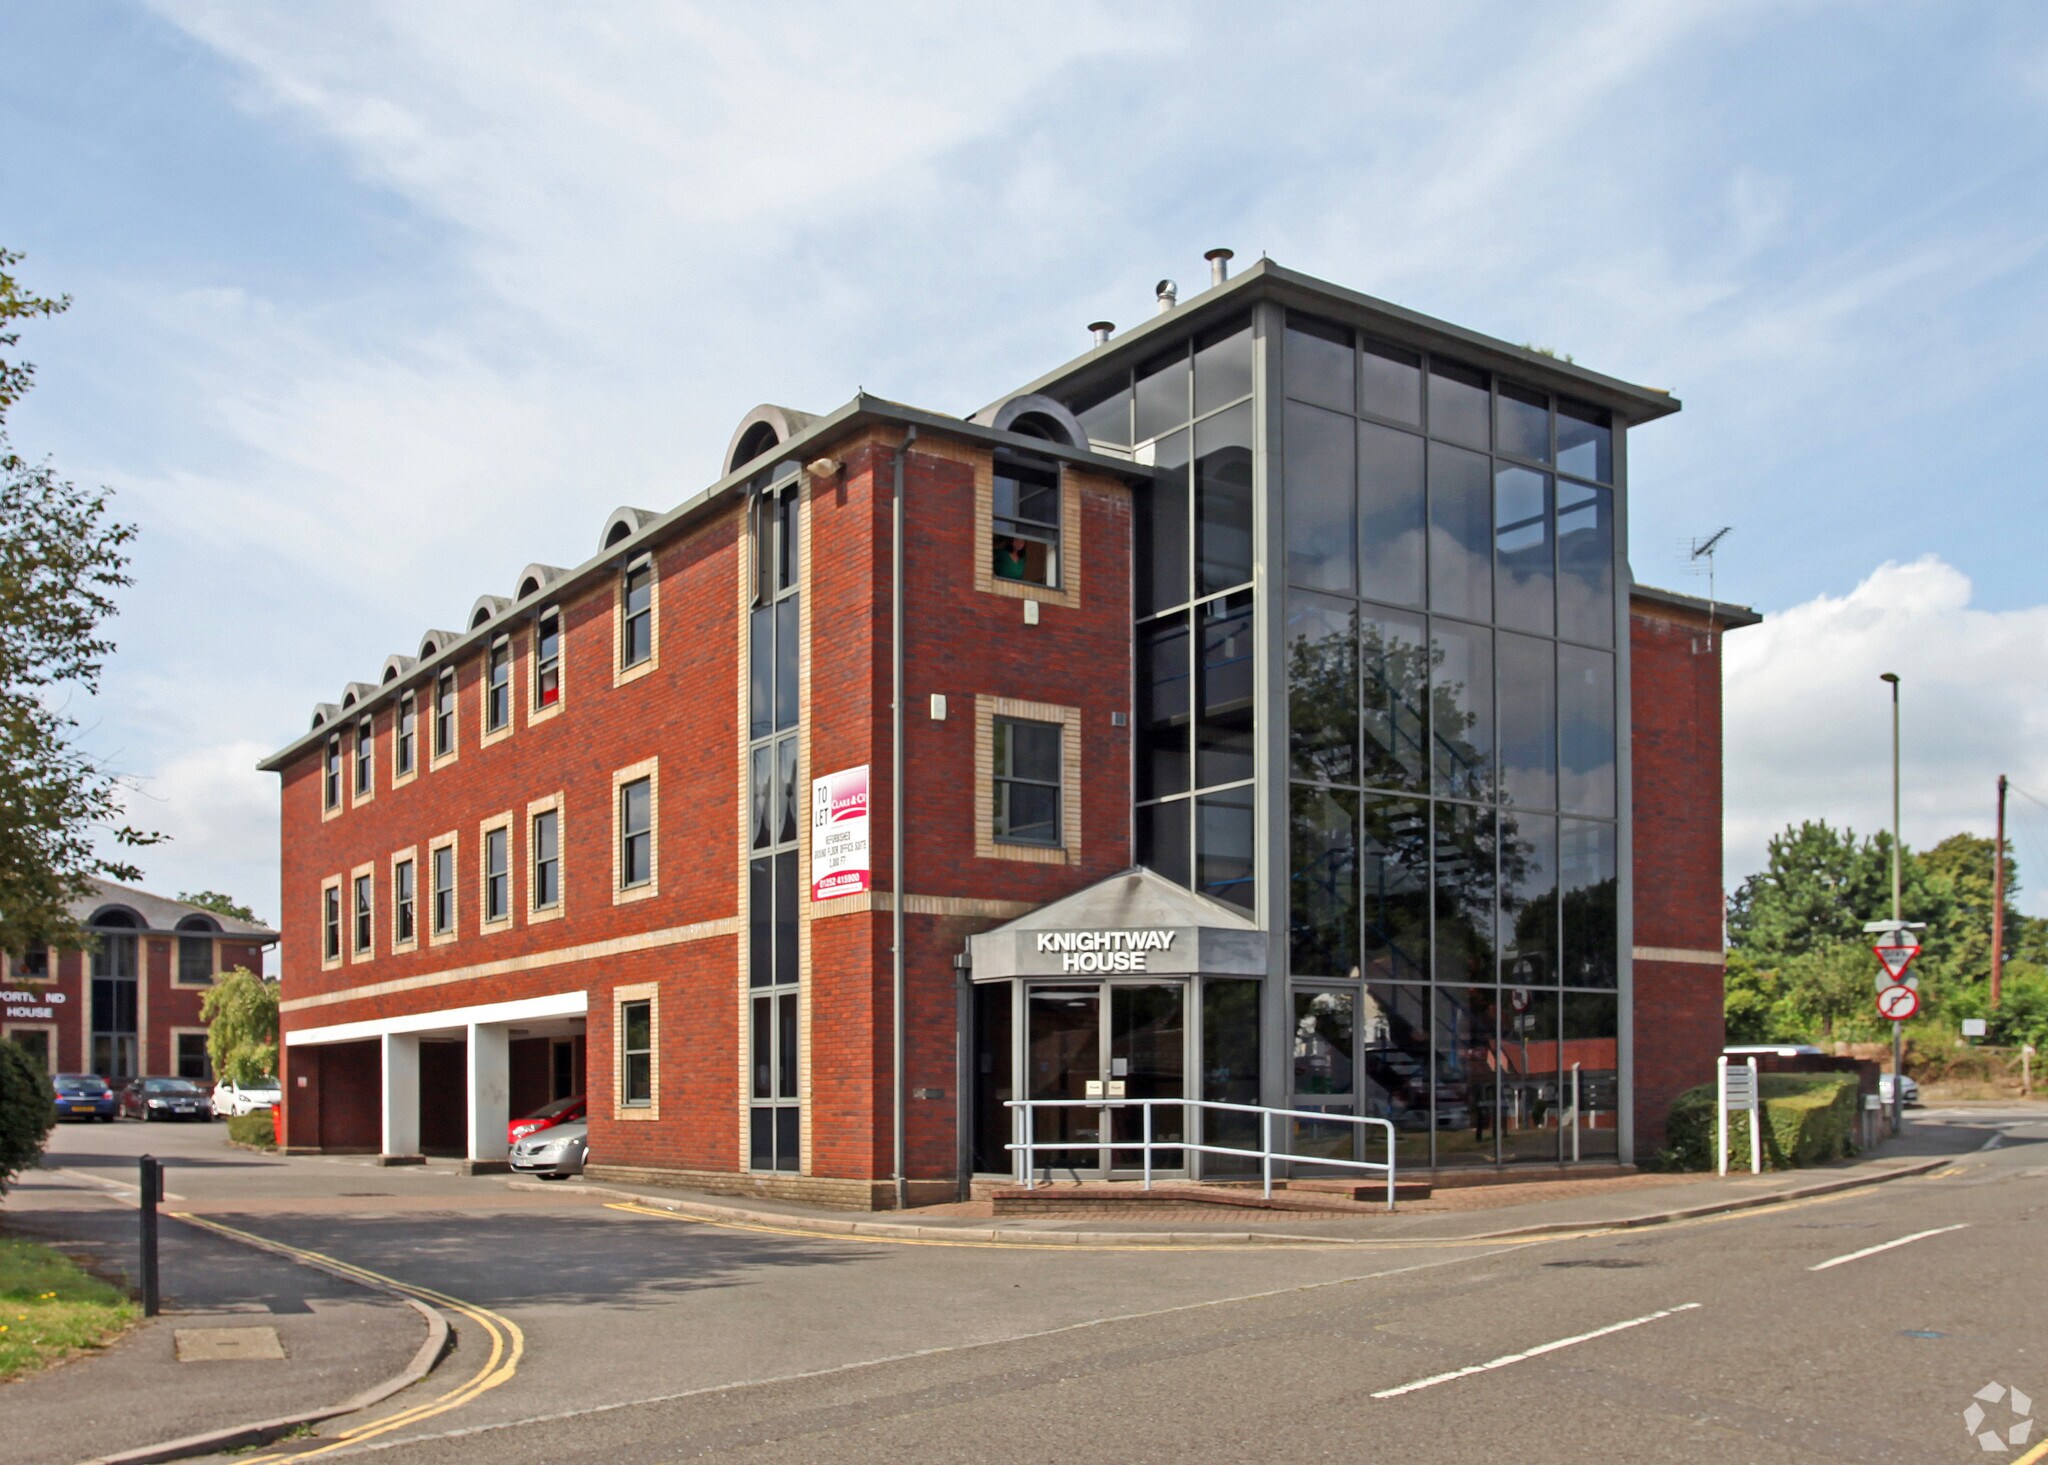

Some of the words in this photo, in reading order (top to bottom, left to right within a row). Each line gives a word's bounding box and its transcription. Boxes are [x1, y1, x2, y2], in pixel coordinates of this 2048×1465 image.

[818, 785, 827, 804] TO
[815, 807, 829, 827] LET
[1037, 930, 1175, 951] KNIGHTWAY
[1063, 951, 1145, 972] HOUSE
[7, 1006, 53, 1018] HOUSE
